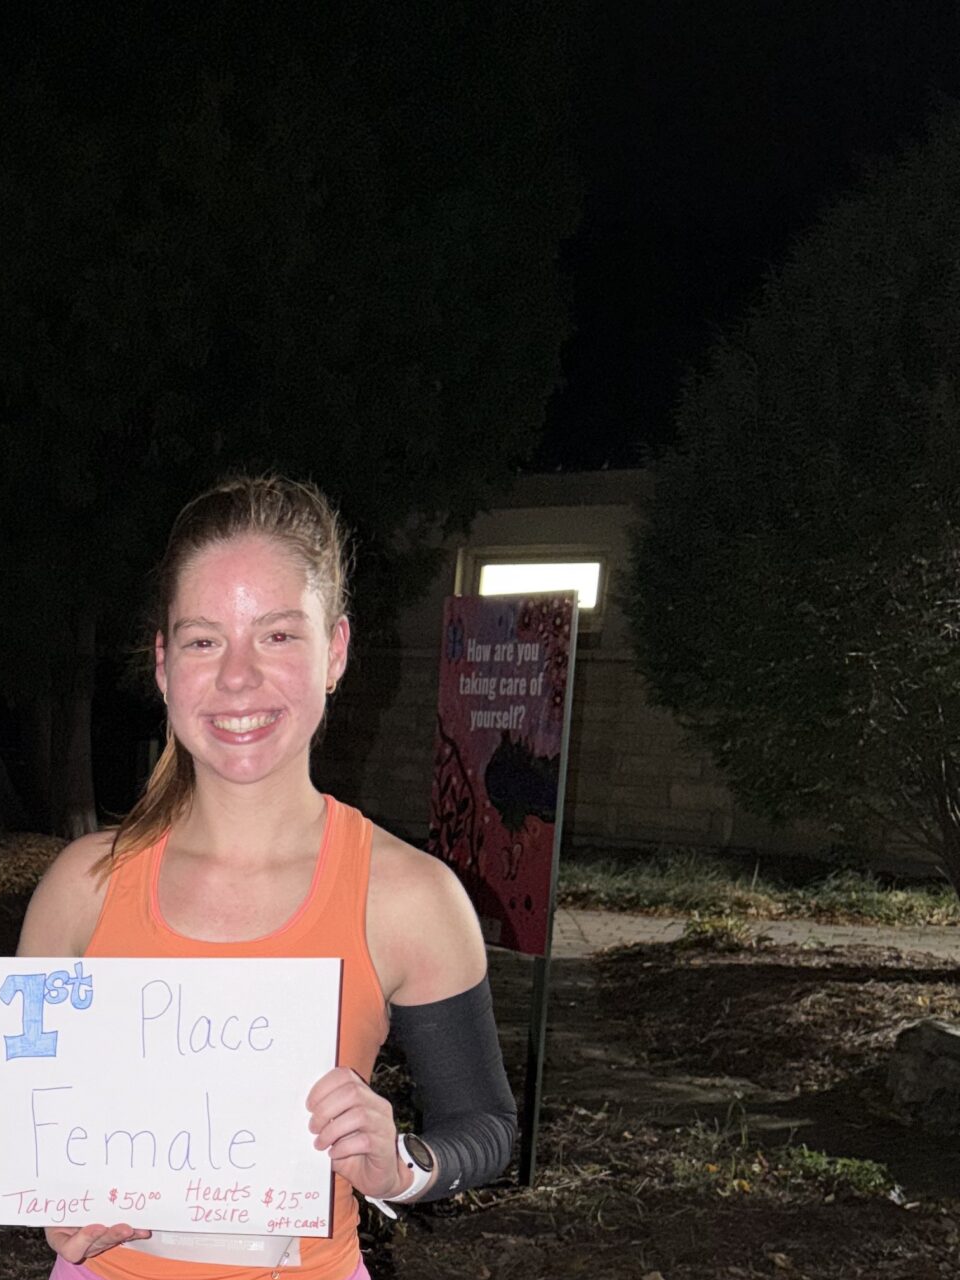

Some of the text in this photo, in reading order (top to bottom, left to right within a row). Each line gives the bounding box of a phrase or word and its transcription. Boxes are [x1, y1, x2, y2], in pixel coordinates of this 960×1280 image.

[467, 638, 540, 665] How are you
[460, 672, 544, 702] taking care of
[470, 704, 526, 731] yourself?
[141, 979, 275, 1059] Place
[31, 1086, 257, 1179] Female
[185, 1177, 251, 1203] Hearts
[2, 1188, 96, 1223] Target
[188, 1203, 250, 1224] Desire
[267, 1216, 327, 1232] gift cards
